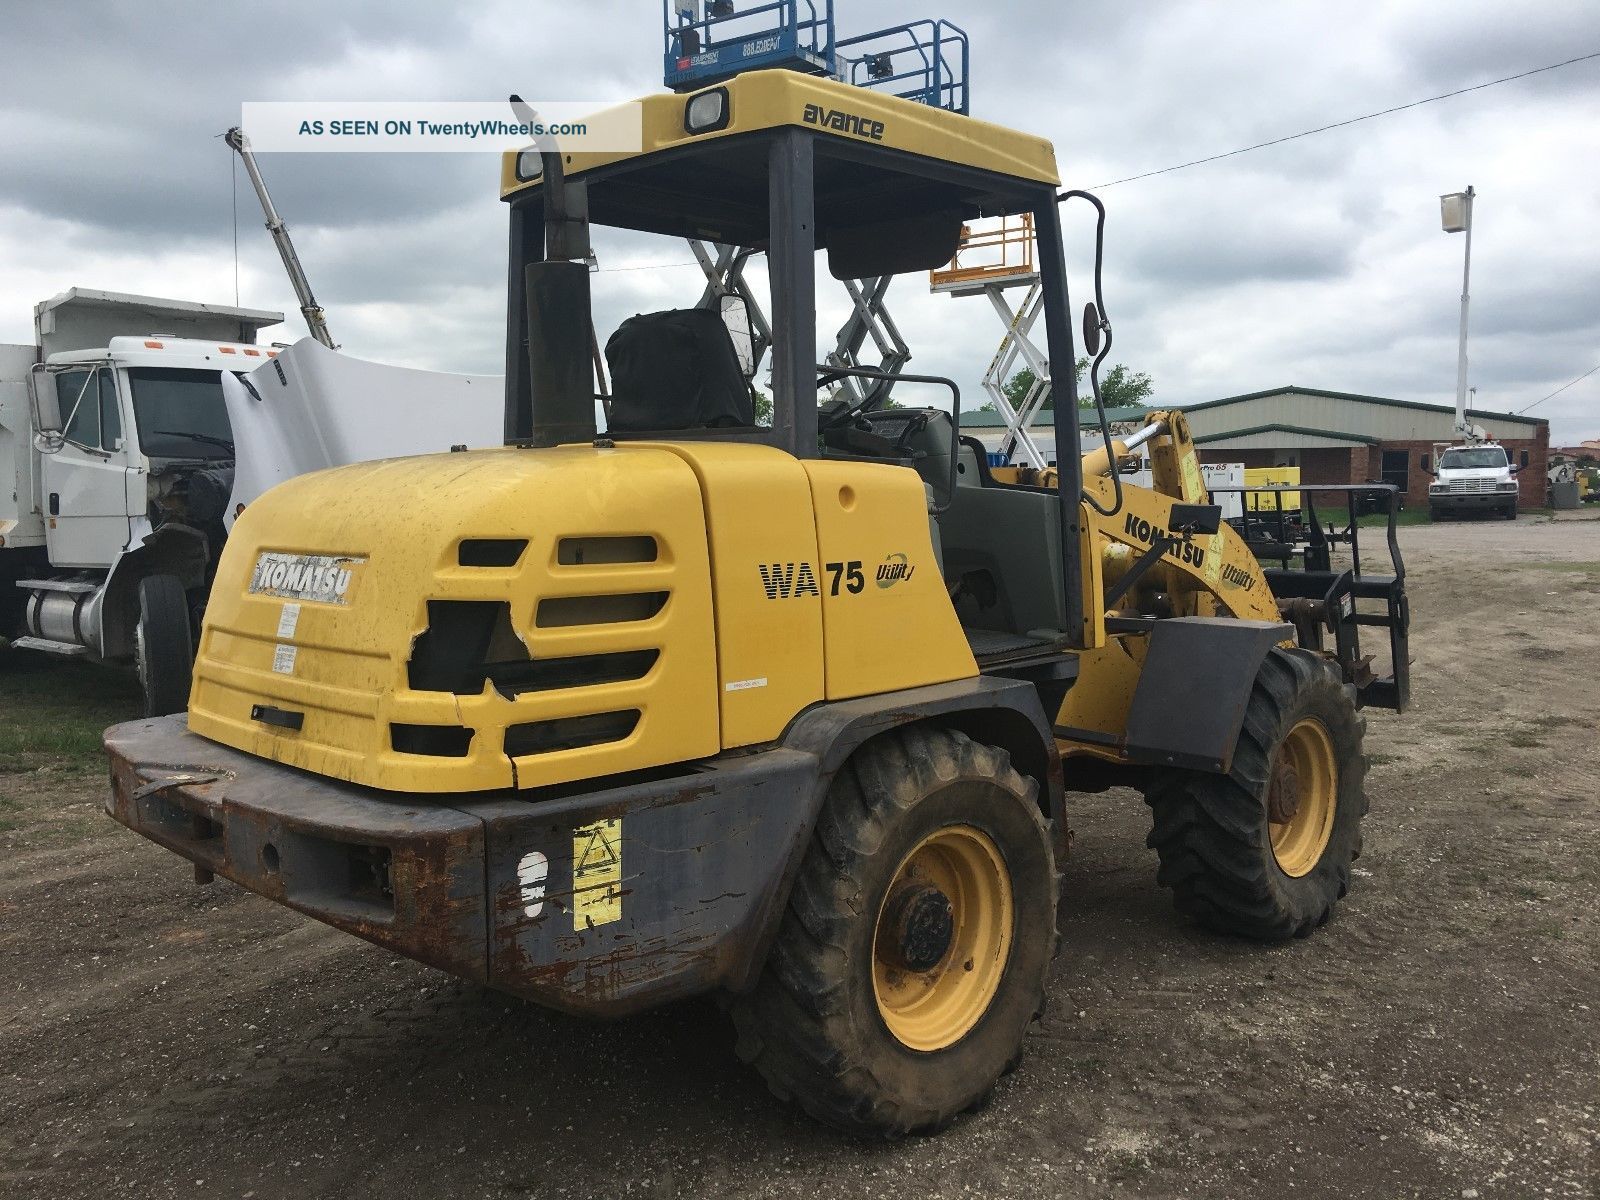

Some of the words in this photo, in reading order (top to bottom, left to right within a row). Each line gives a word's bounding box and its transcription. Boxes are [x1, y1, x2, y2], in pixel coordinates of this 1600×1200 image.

[803, 104, 885, 140] avance
[258, 562, 353, 595] KOMATSU
[758, 562, 820, 600] WA
[825, 560, 866, 597] 75
[876, 562, 916, 582] Utility
[1222, 563, 1257, 592] Utility
